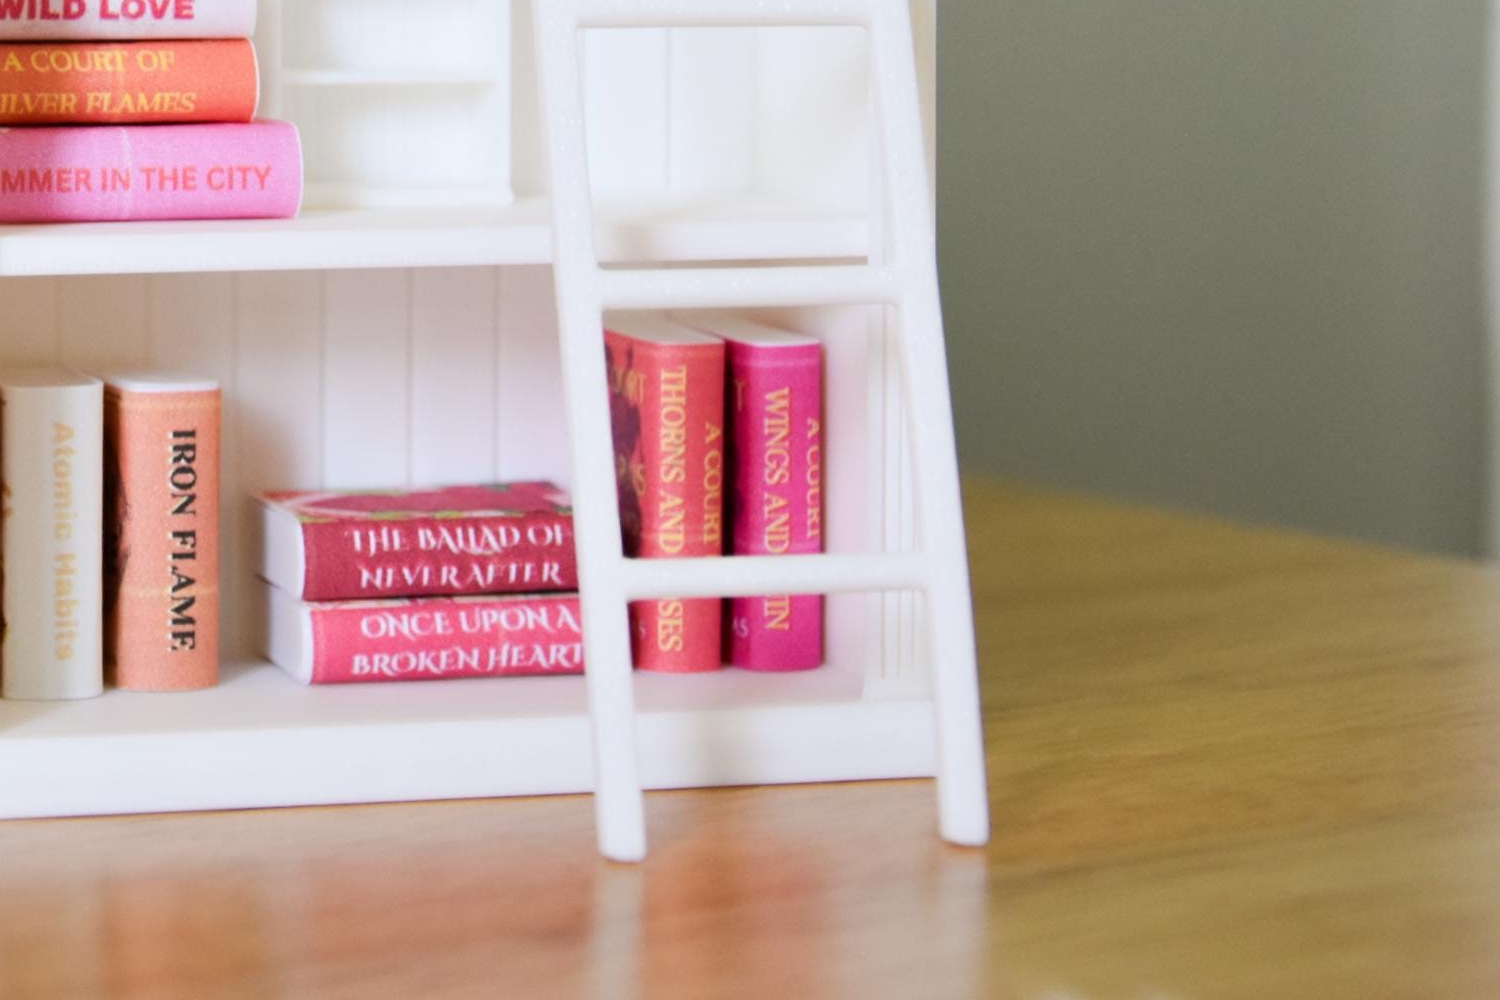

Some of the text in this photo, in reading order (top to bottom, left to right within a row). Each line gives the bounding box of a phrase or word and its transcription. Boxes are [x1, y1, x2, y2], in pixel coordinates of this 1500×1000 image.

[1, 49, 175, 73] A COURT OF
[86, 90, 197, 115] FLAMES
[101, 167, 132, 192] IN
[140, 165, 198, 191] THE
[206, 163, 274, 191] CITY
[762, 386, 790, 486] WINGS
[806, 416, 821, 439] A
[703, 420, 722, 546] A COURT
[656, 364, 687, 653] THORNS AND SES
[763, 492, 790, 554] AND
[53, 421, 80, 662] Atomic Habits
[168, 429, 197, 653] IRON FLAME
[345, 521, 567, 556] THE BALLAD OF
[356, 560, 564, 590] NEVER AFTER
[360, 602, 581, 641] ONCE UPON A
[351, 644, 481, 677] BROKEN
